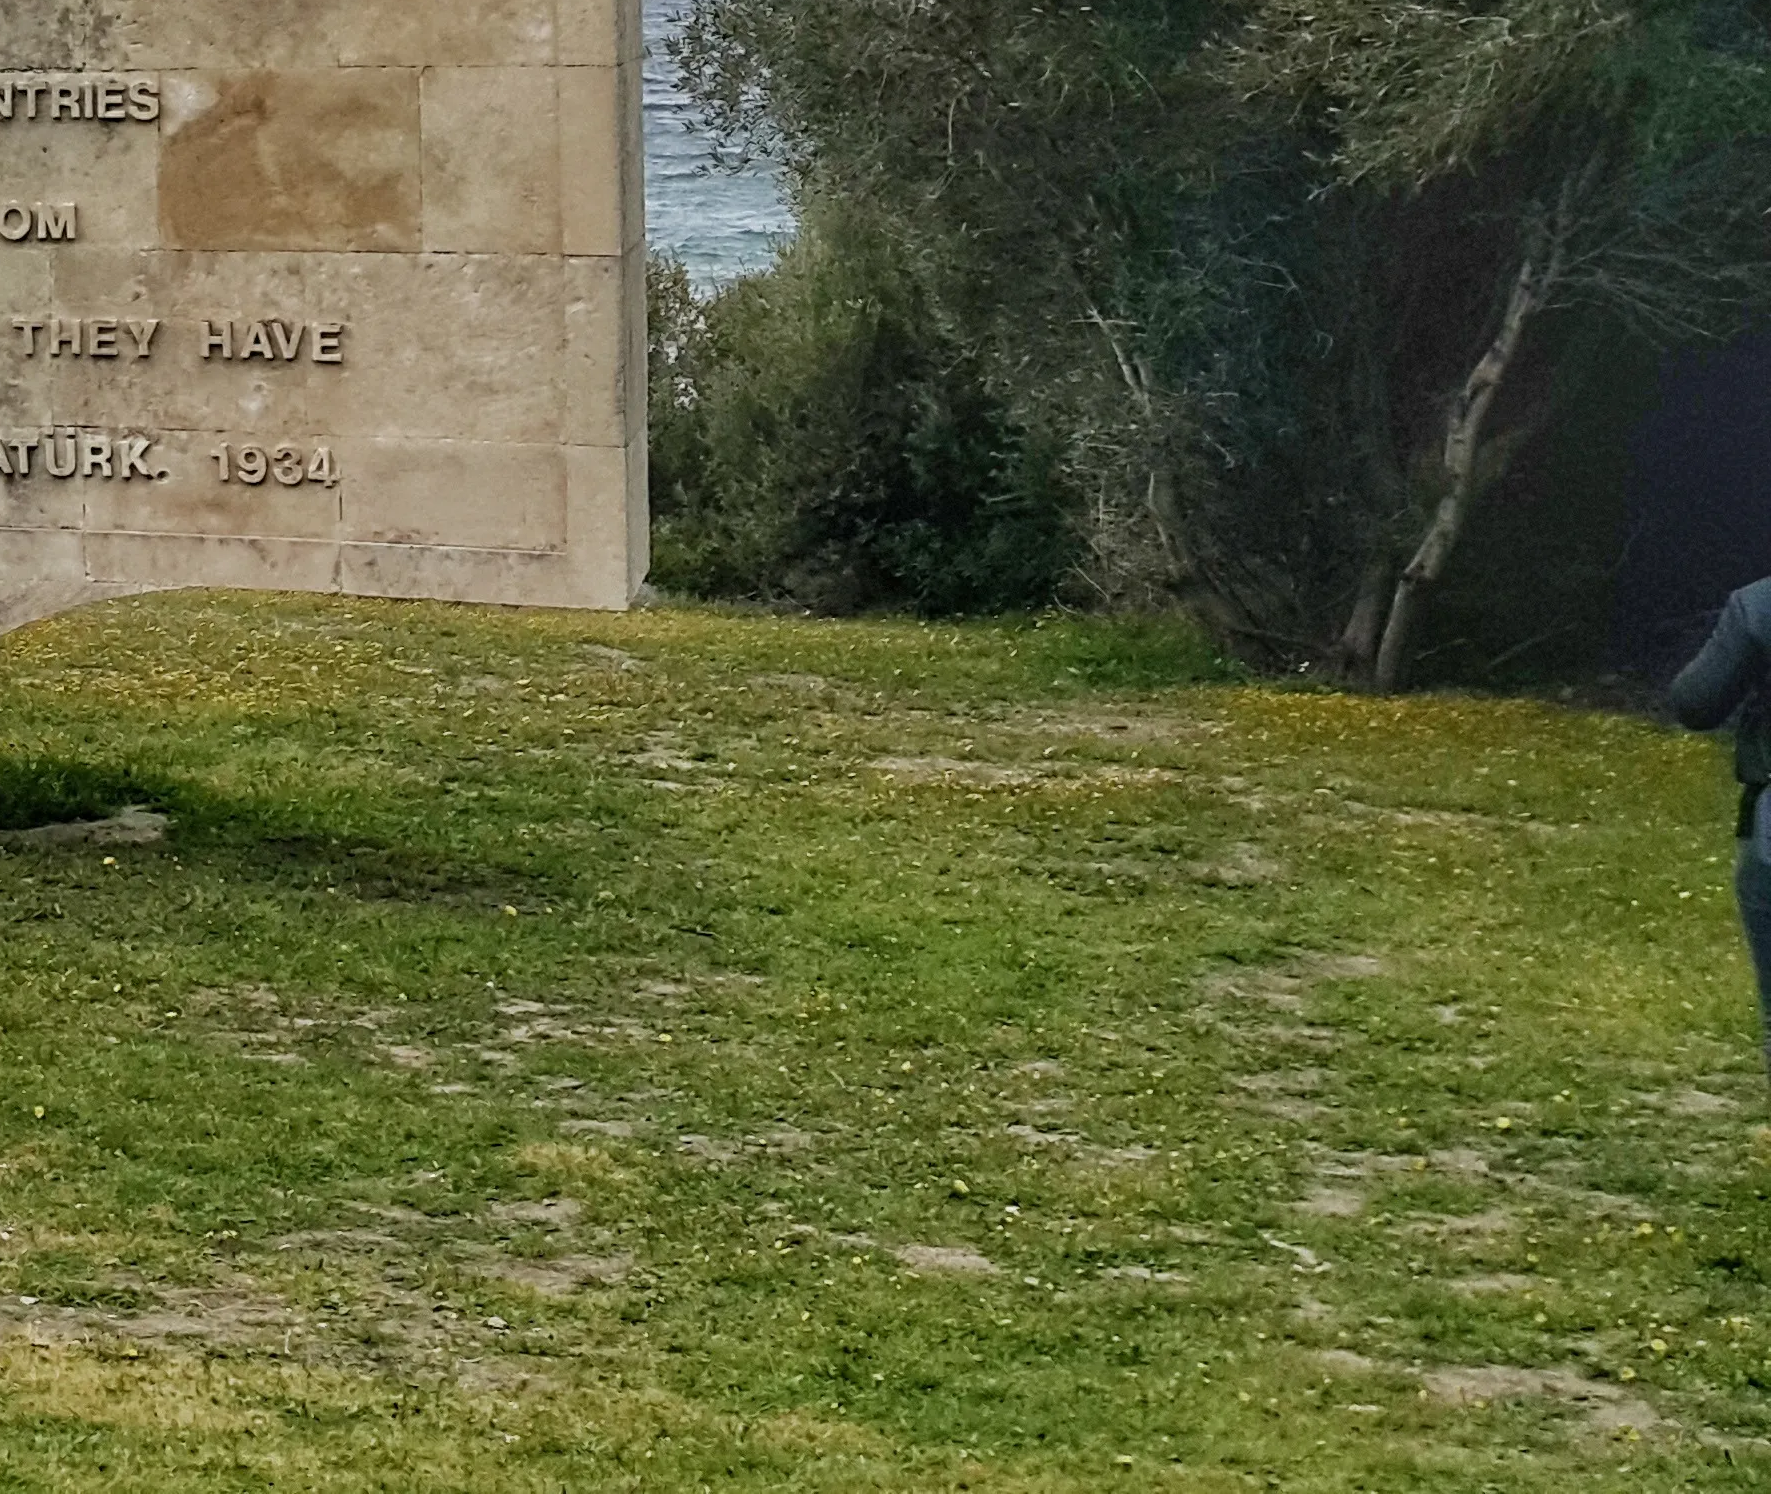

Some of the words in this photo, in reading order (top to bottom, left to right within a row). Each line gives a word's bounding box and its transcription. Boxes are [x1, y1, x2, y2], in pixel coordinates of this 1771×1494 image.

[13, 317, 162, 359] THEY
[199, 318, 346, 364] HAVE
[211, 440, 342, 488] 1934
